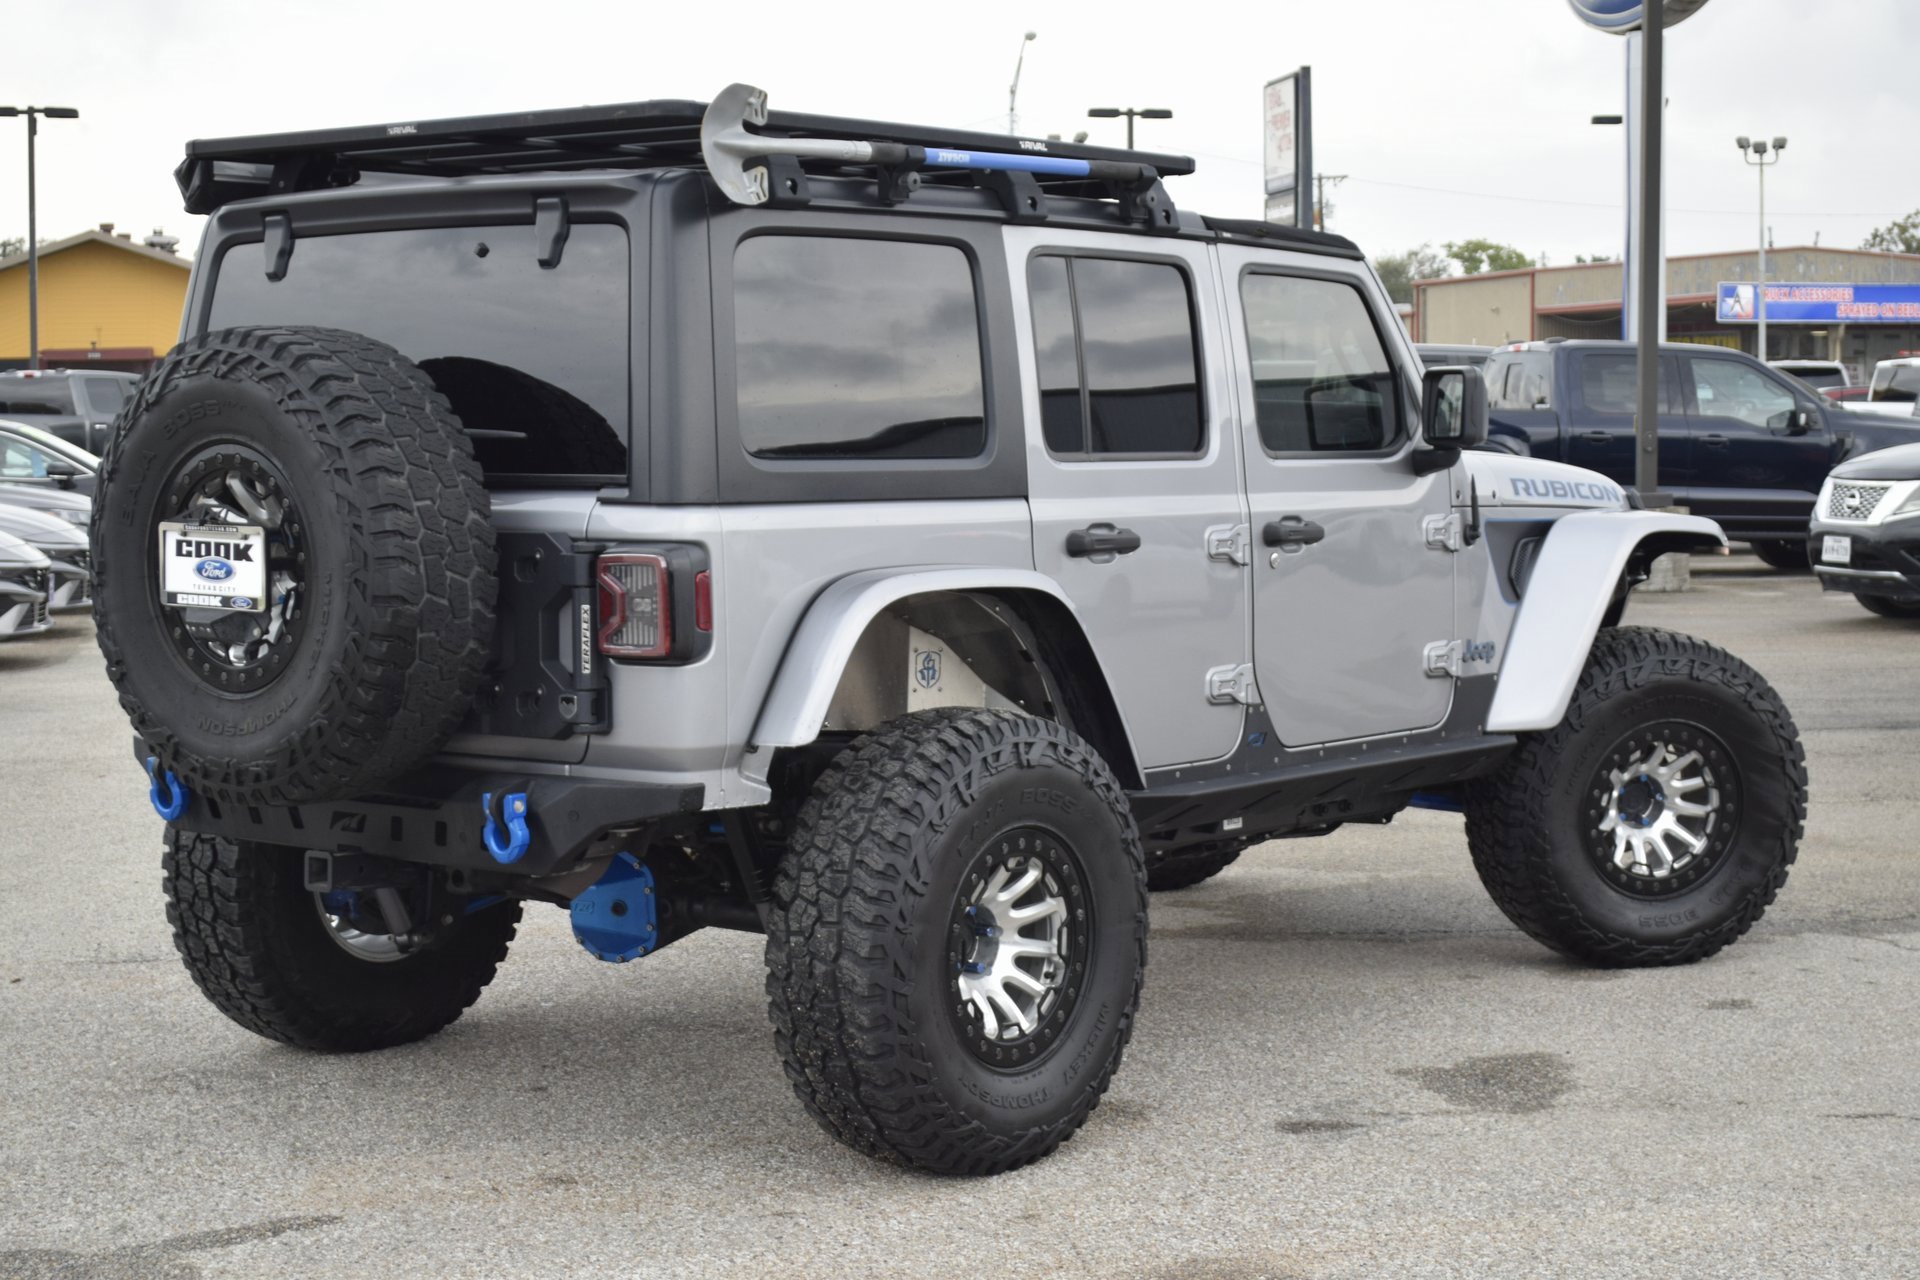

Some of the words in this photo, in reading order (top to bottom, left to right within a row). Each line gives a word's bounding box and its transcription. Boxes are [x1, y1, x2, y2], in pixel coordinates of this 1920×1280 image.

[1023, 140, 1048, 151] RIVAL
[1759, 287, 1789, 301] RUCK
[1791, 287, 1852, 301] ACCESSORIES
[1510, 478, 1621, 503] RUBICON
[176, 539, 254, 562] COOK
[202, 560, 227, 579] Ford
[582, 607, 590, 672] TERAFLEX
[1462, 639, 1496, 664] Jeep
